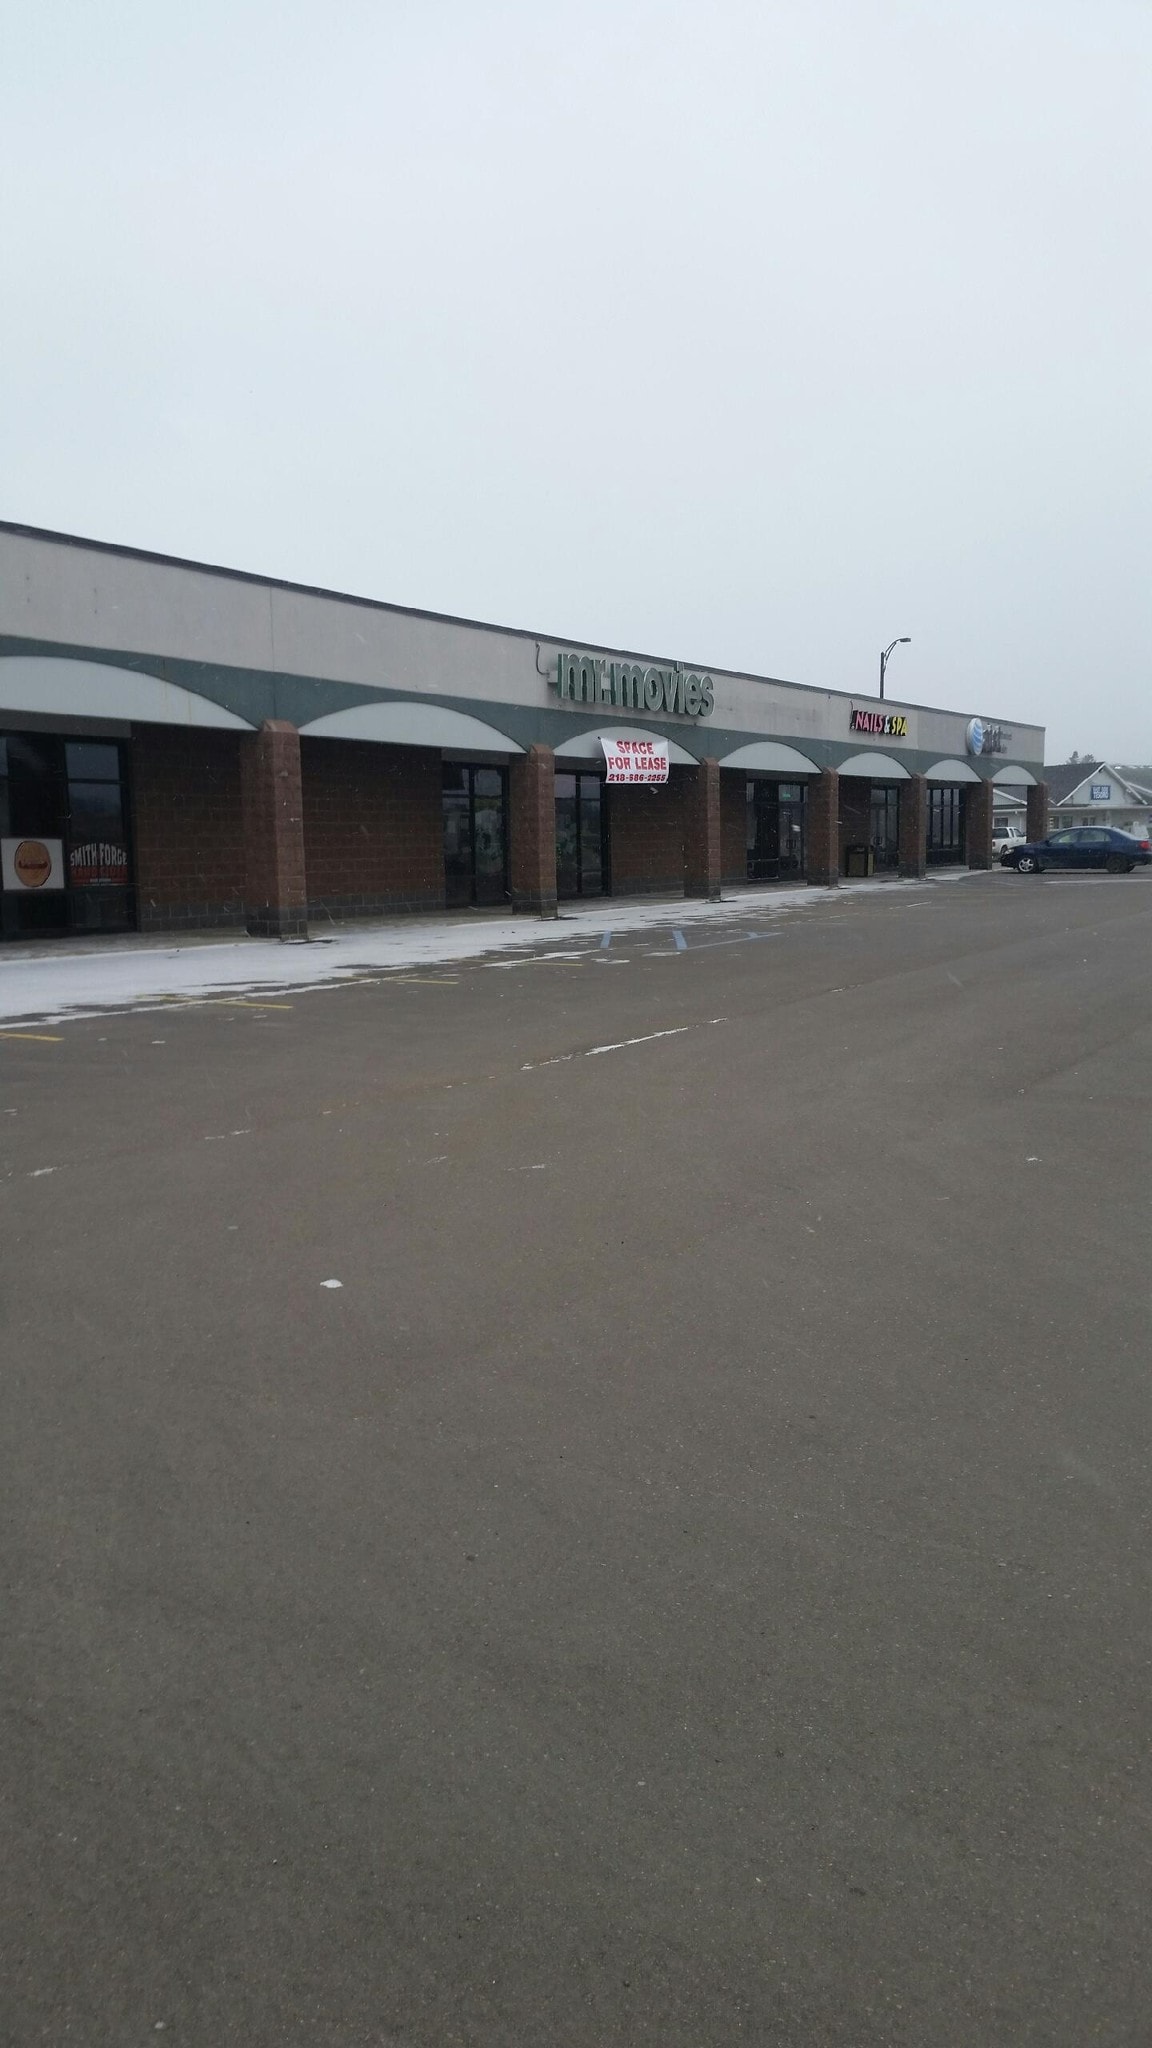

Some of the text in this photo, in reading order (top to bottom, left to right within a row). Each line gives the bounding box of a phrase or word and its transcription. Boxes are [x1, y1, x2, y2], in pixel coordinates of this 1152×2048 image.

[853, 710, 883, 732] NAILS
[891, 717, 909, 736] SPA
[616, 741, 655, 755] SPACE
[608, 757, 667, 771] FOR LEASE
[70, 843, 98, 867] SMITH
[99, 843, 128, 866] FORGE
